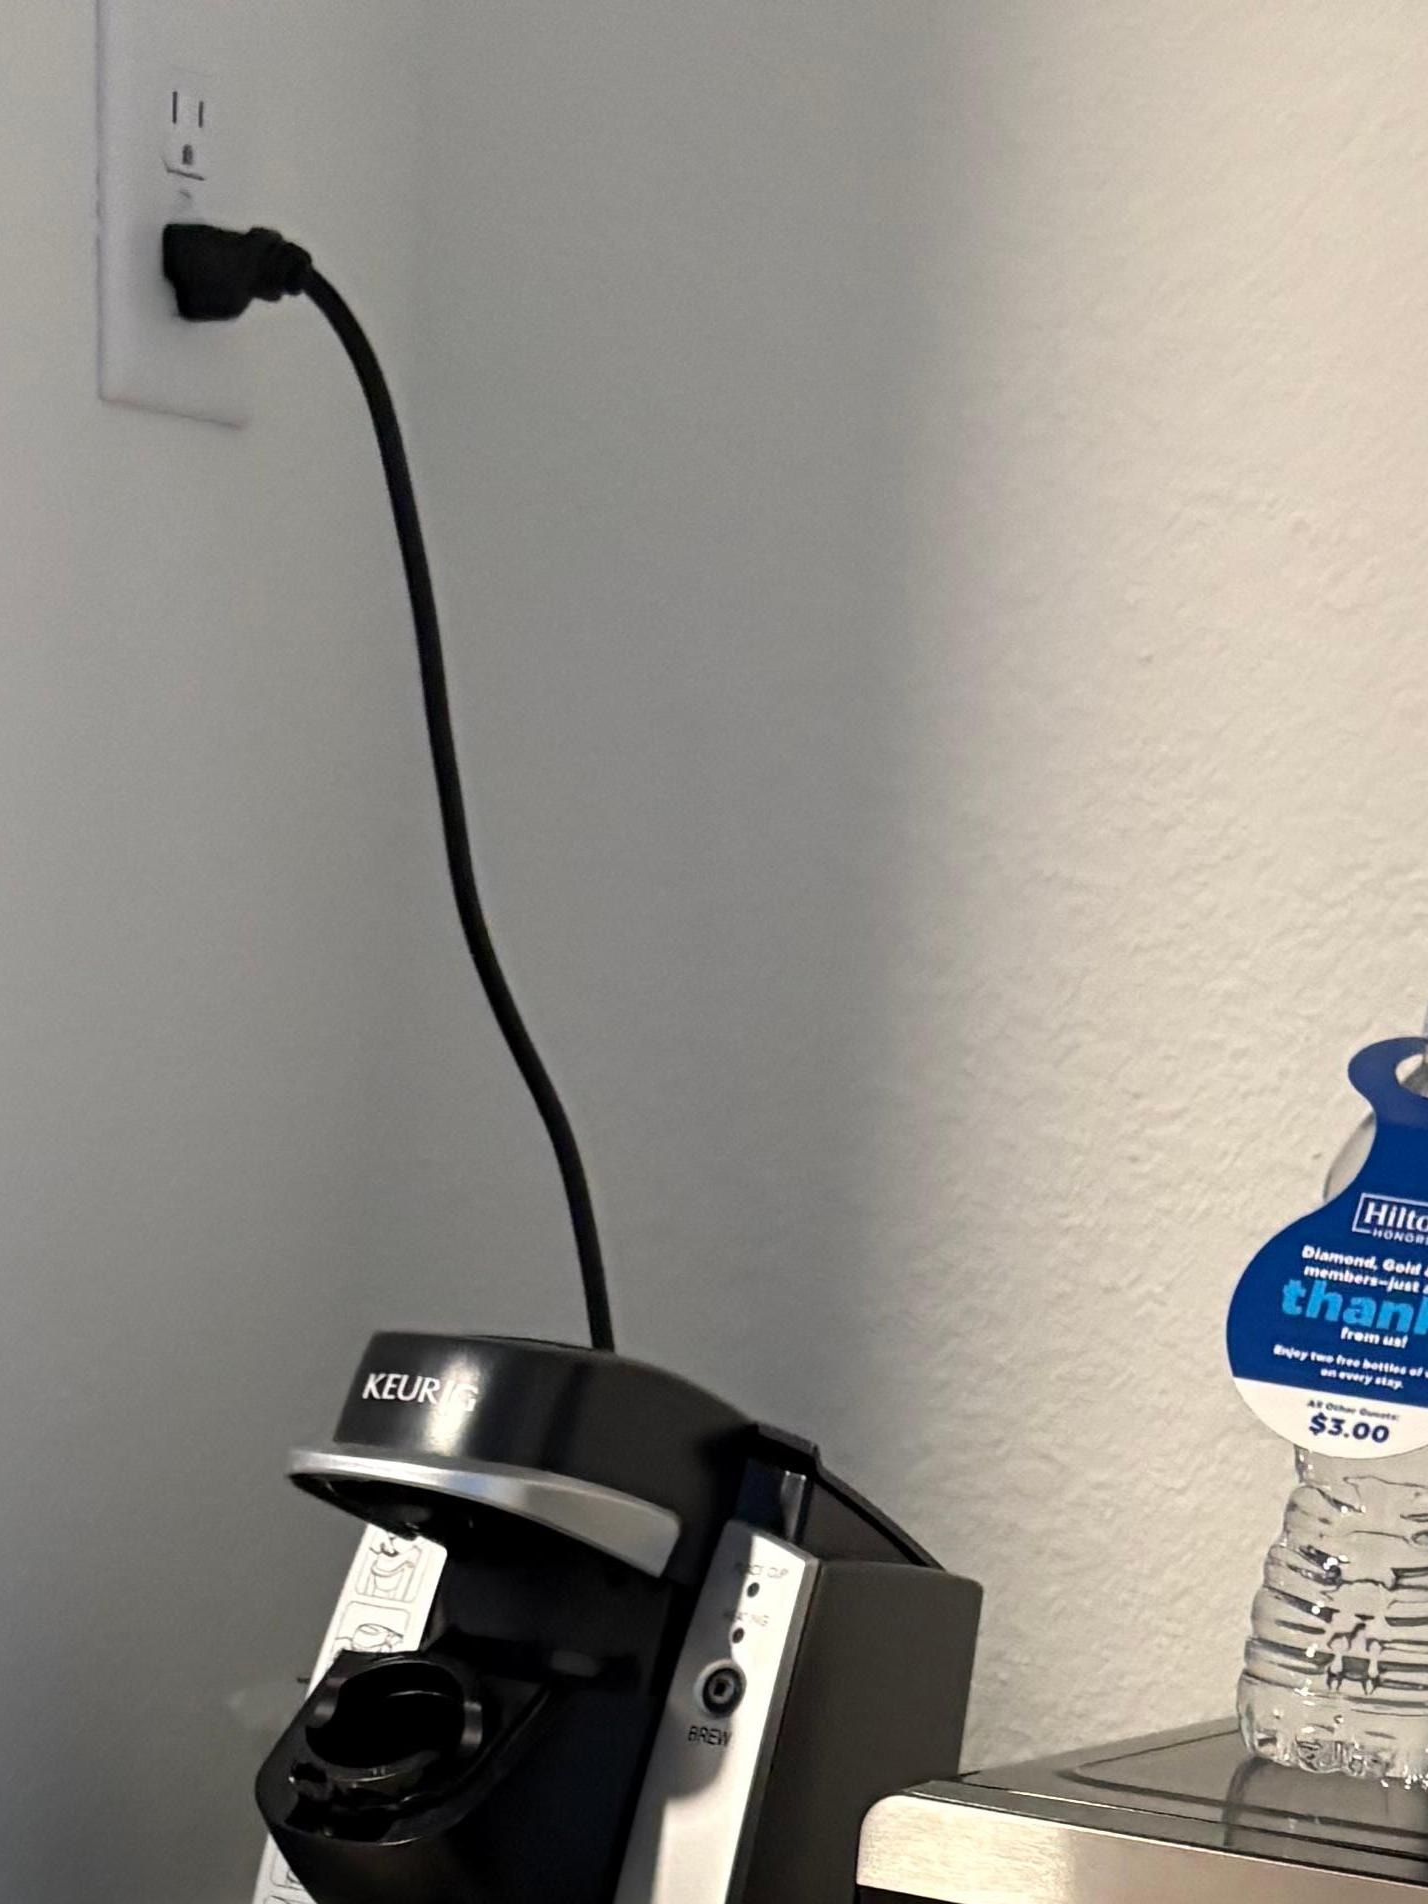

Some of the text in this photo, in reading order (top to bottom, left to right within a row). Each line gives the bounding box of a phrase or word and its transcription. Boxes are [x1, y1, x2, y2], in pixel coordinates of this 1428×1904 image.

[1301, 1244, 1378, 1271] Diamond,
[1382, 1258, 1422, 1276] Gold
[1340, 1327, 1409, 1349] from us!
[1273, 1344, 1308, 1362] Enjoy
[1311, 1351, 1334, 1364] two
[1336, 1354, 1360, 1367] free
[1363, 1359, 1406, 1375] bottles
[1409, 1367, 1424, 1377] of
[1321, 1368, 1404, 1390] on every stay.
[362, 1373, 479, 1412] KEURIG
[1325, 1401, 1357, 1414] Other
[1308, 1412, 1390, 1443] $3.00
[687, 1725, 733, 1747] BREW
